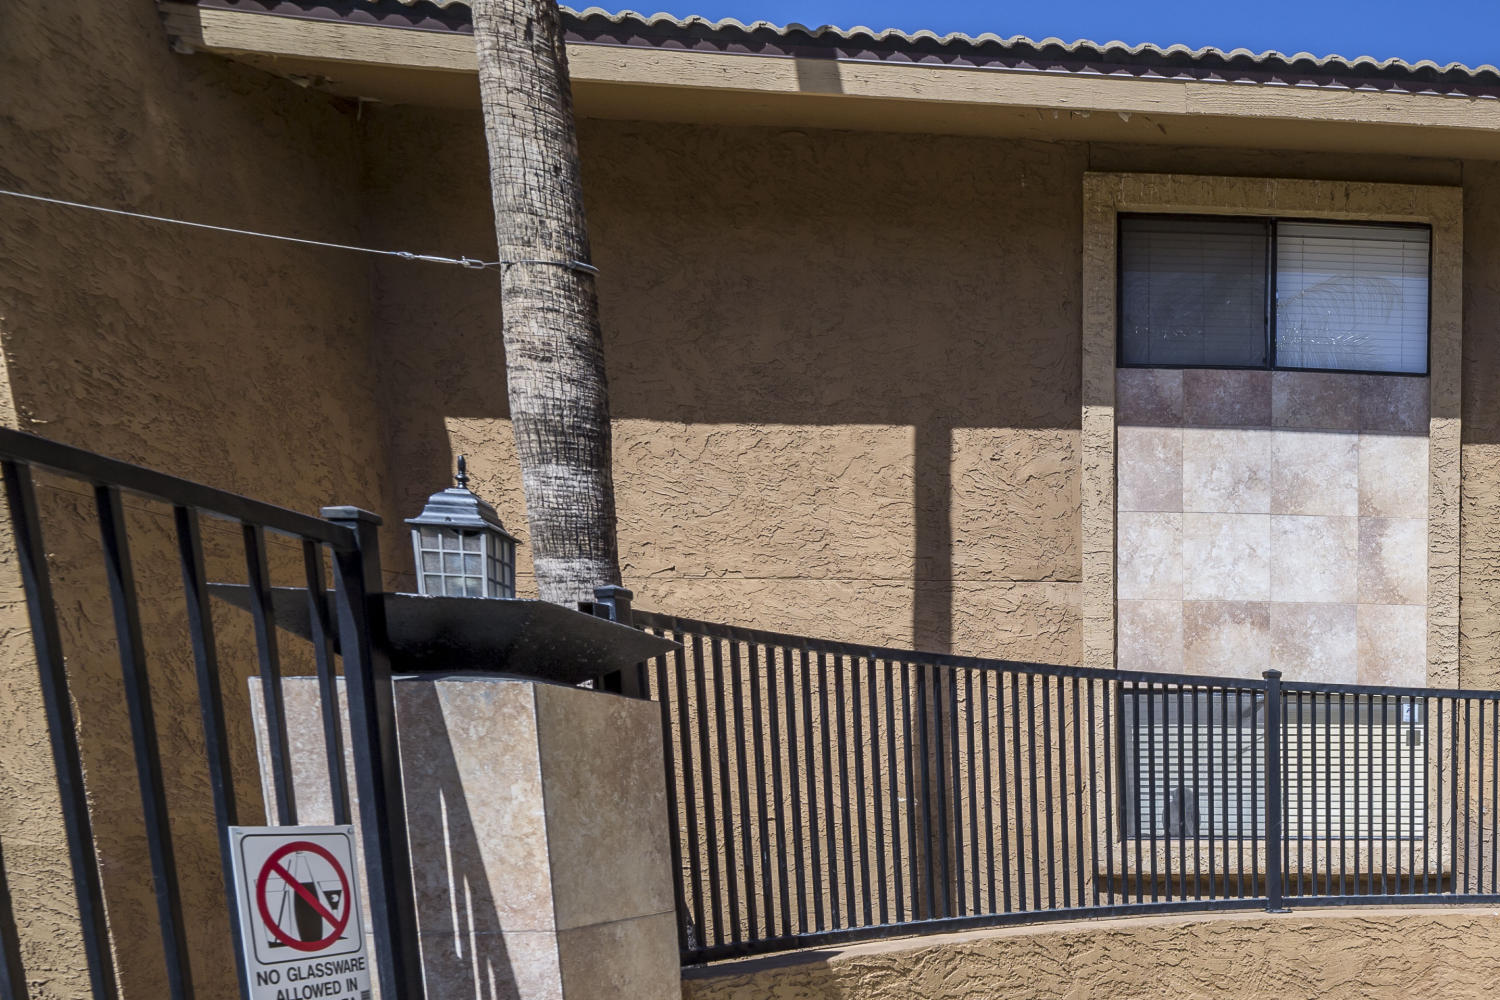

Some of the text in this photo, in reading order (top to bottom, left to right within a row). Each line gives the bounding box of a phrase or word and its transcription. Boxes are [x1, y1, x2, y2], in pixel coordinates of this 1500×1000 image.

[256, 957, 366, 986] NO GLASSWARE
[346, 977, 358, 992] IN
